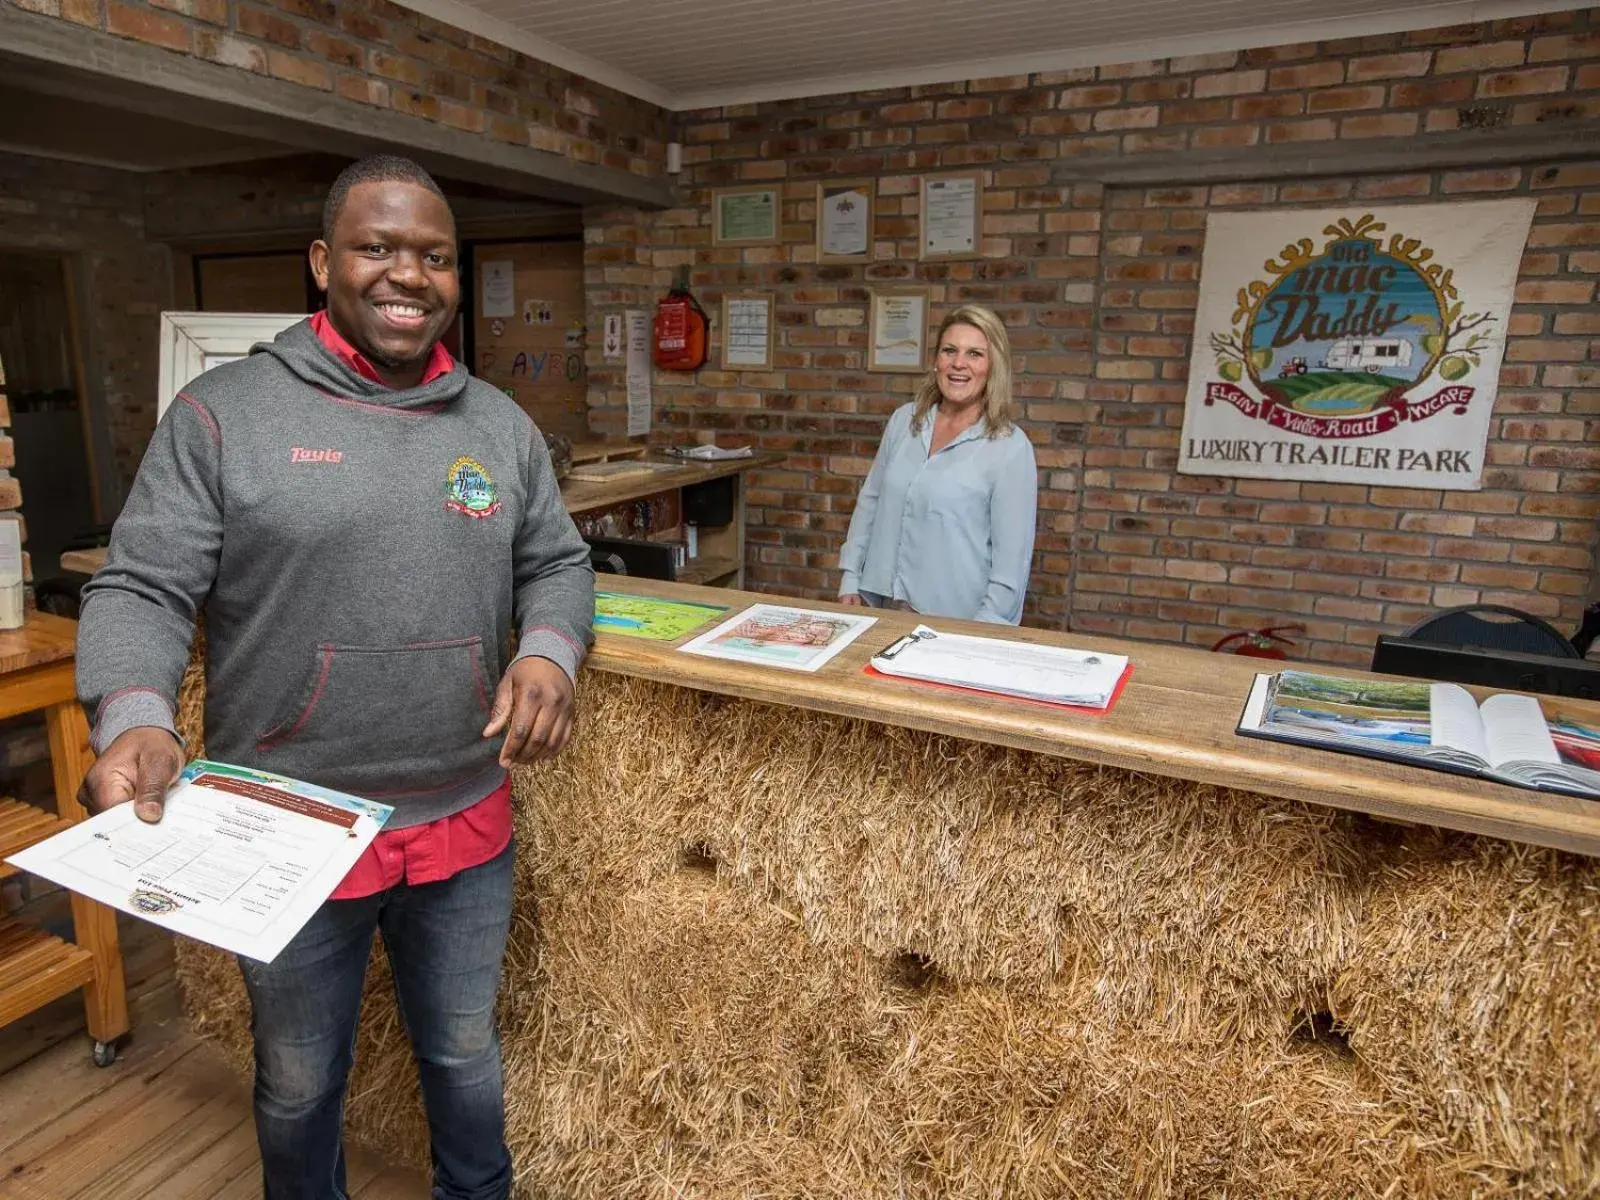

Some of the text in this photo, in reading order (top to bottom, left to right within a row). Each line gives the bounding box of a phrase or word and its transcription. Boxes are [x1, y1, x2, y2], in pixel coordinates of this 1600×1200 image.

[1256, 293, 1412, 347] Daddy
[1211, 384, 1256, 412] ELGIN
[1323, 416, 1378, 437] Road
[1187, 438, 1472, 473] LUXURY TRAILER PARK
